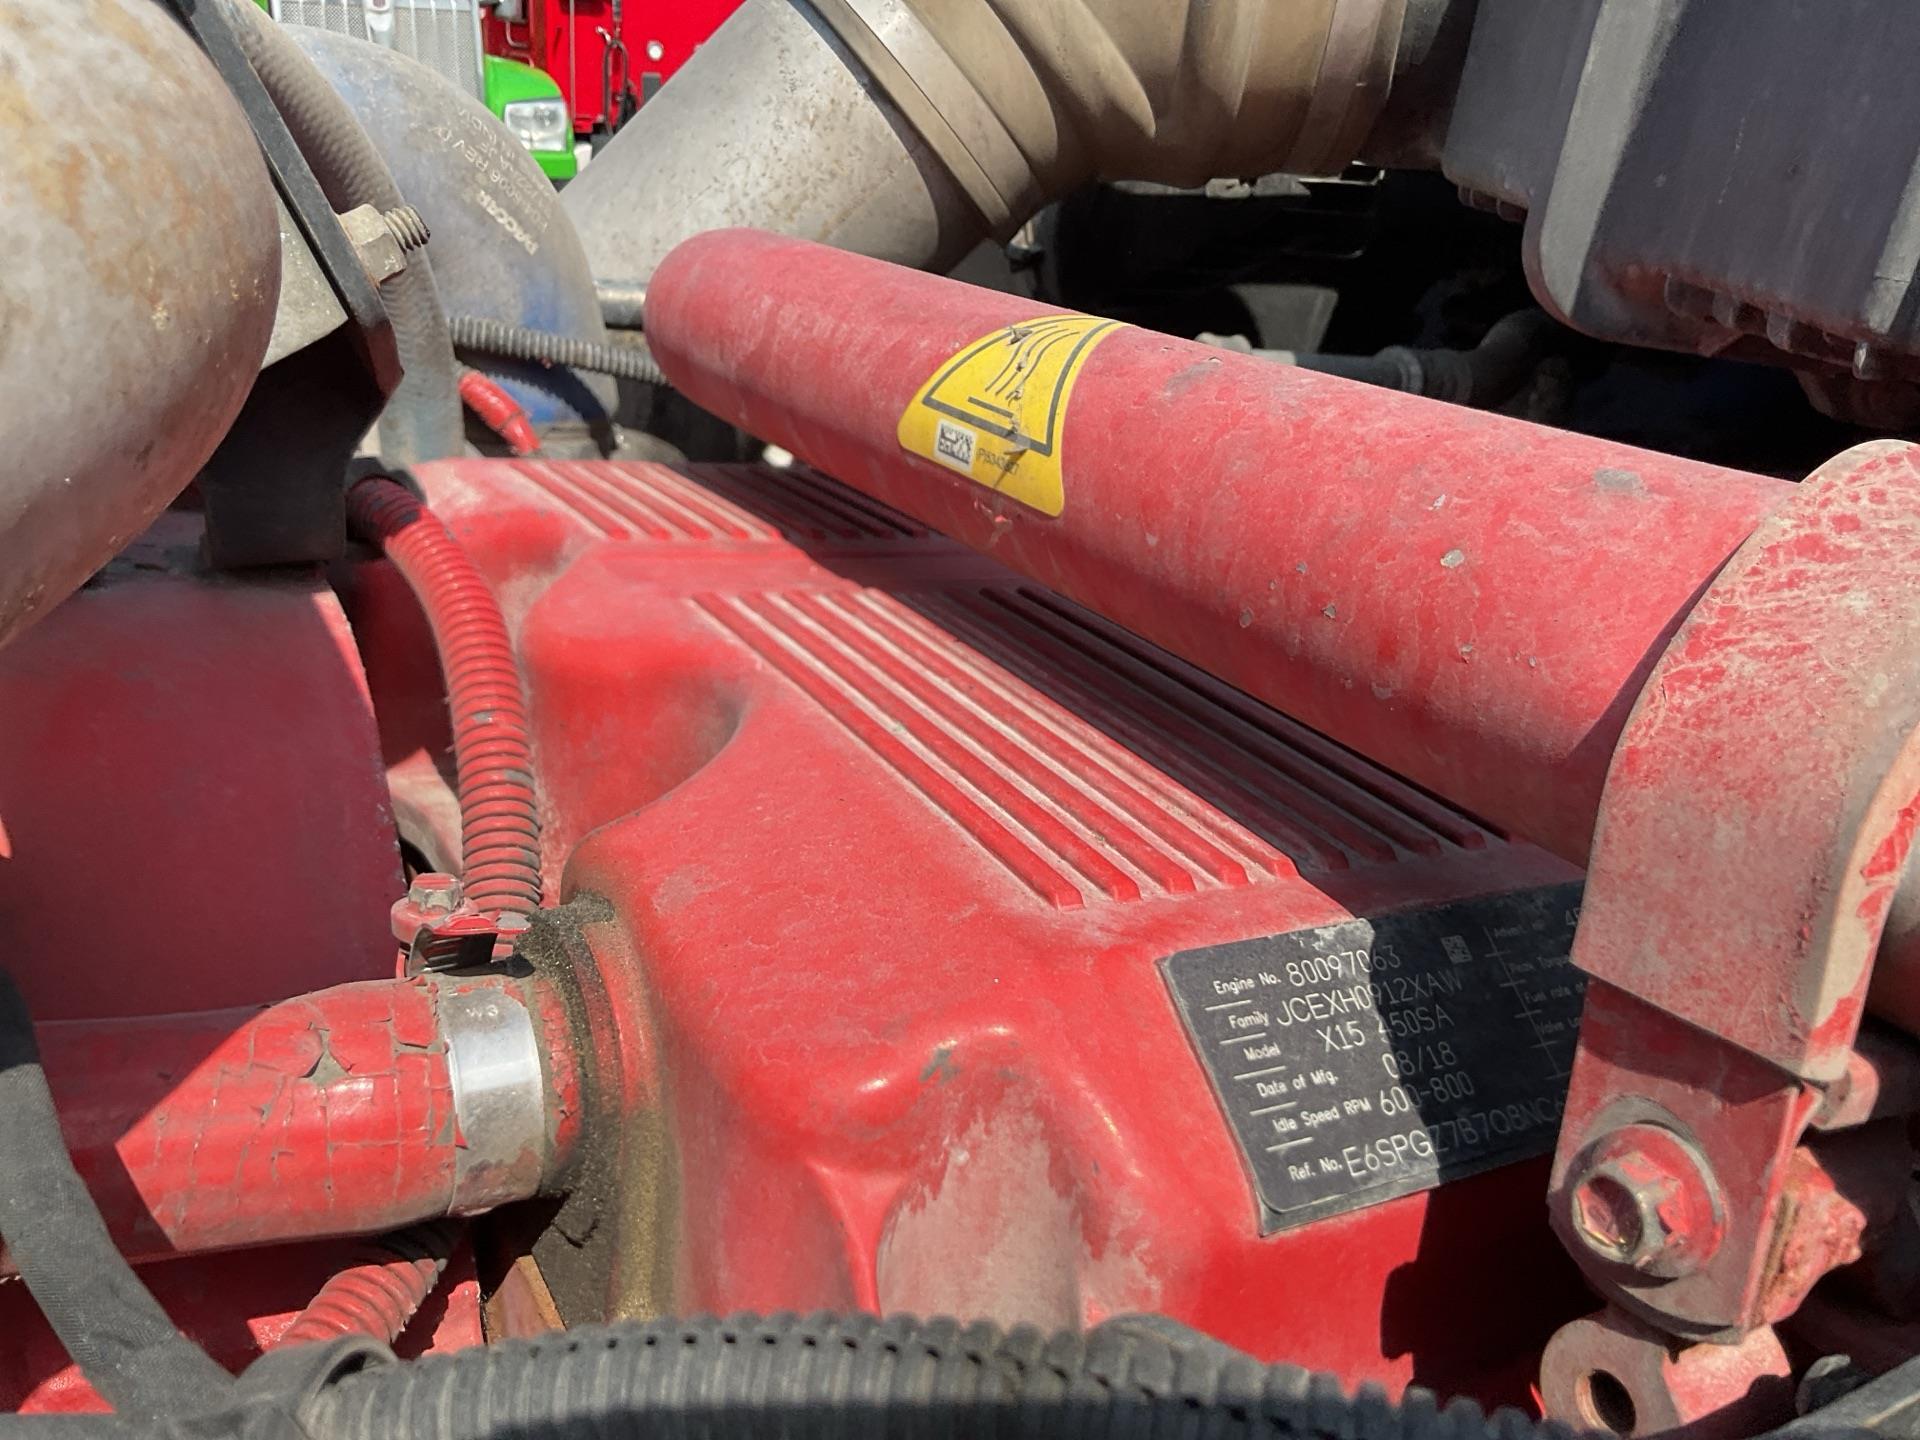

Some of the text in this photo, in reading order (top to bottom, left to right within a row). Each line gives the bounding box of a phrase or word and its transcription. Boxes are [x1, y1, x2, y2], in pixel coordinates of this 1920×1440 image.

[1213, 945, 1400, 997] Engine No. 80097063
[1228, 969, 1463, 1030] Family JCEXH0912XAW
[1242, 1005, 1456, 1060] Model X15 450SA
[1256, 1041, 1457, 1097] Date of Mfg. 08/18
[1272, 1071, 1475, 1133] Idle Speed RPM 600-800
[1287, 1163, 1317, 1181] Ref.
[1318, 1157, 1343, 1174] No.
